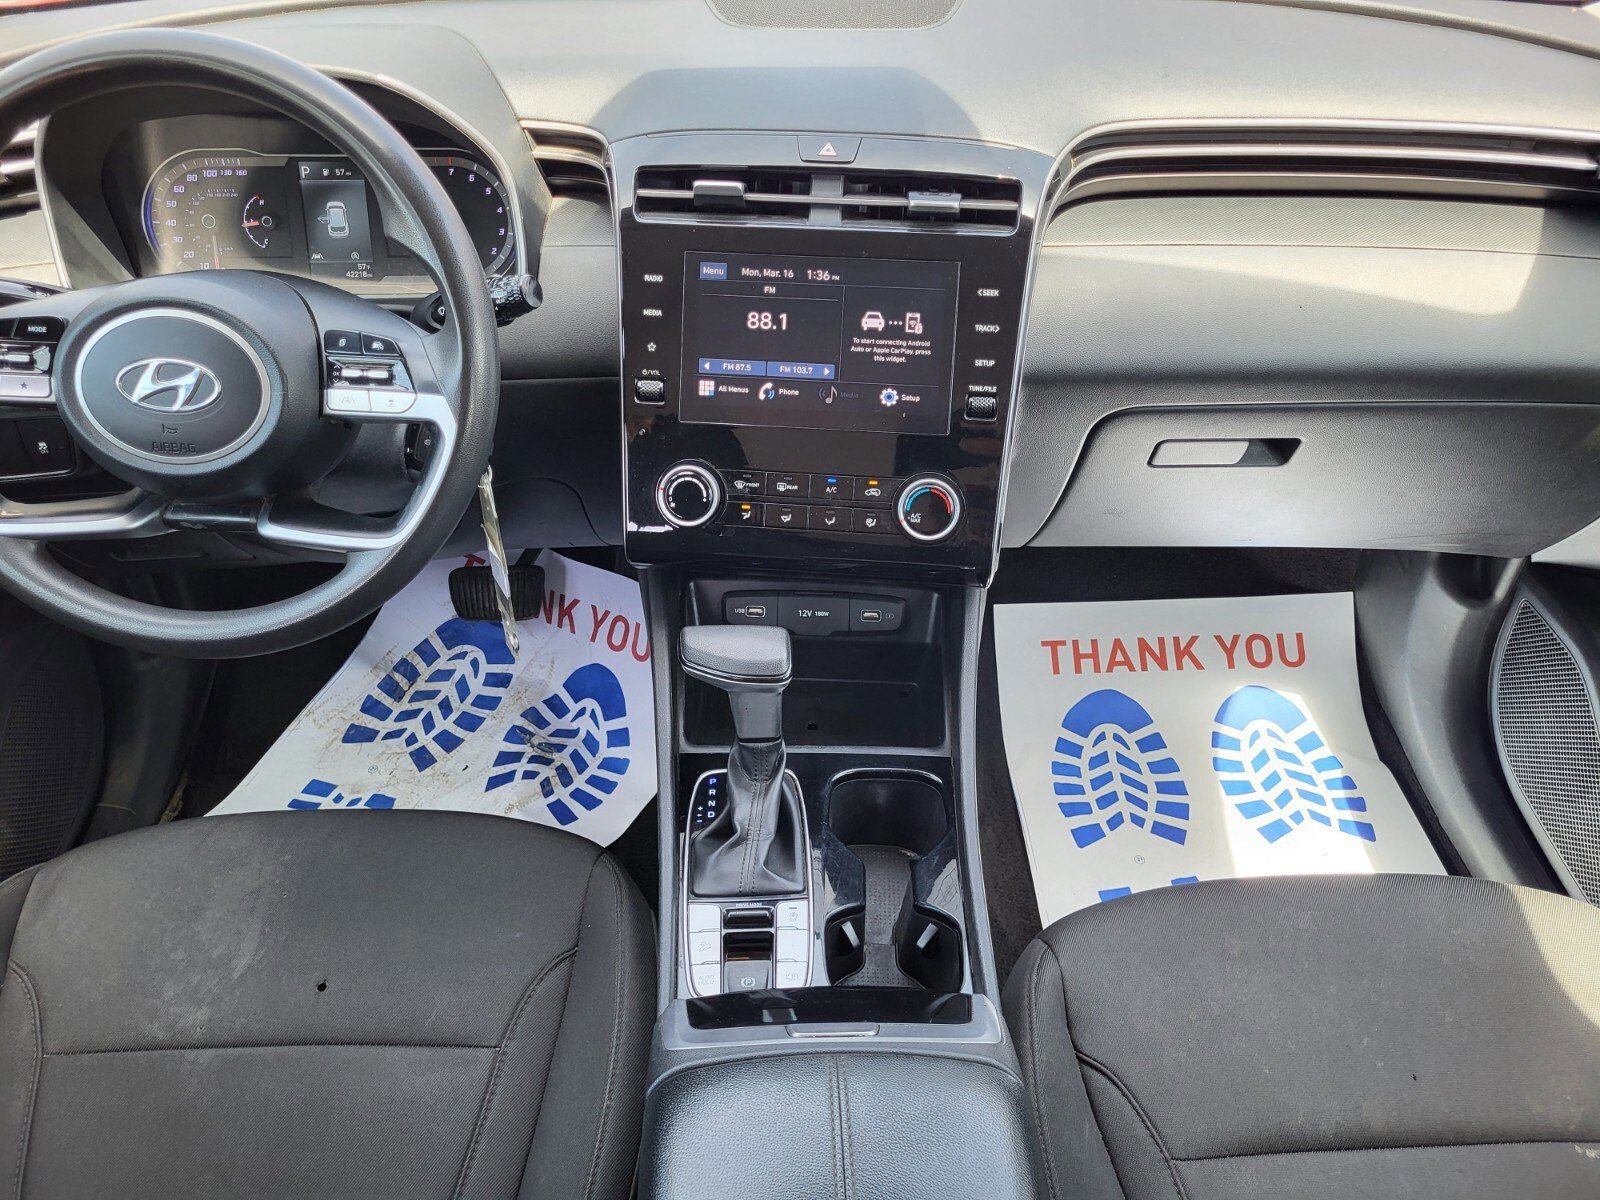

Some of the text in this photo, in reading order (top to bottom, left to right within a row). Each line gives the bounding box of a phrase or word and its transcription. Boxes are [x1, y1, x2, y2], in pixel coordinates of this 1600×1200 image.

[202, 170, 218, 178] 100
[301, 166, 310, 178] P
[703, 266, 724, 275] Menu
[742, 268, 794, 278] Mon, Mar. 16
[807, 270, 830, 280] 1:36
[764, 286, 776, 294] FM
[748, 312, 788, 330] 88.1
[792, 366, 813, 374] 103.7
[152, 442, 196, 454] AIRBAG
[589, 604, 650, 662] YOU
[1041, 632, 1306, 675] THANK YOU
